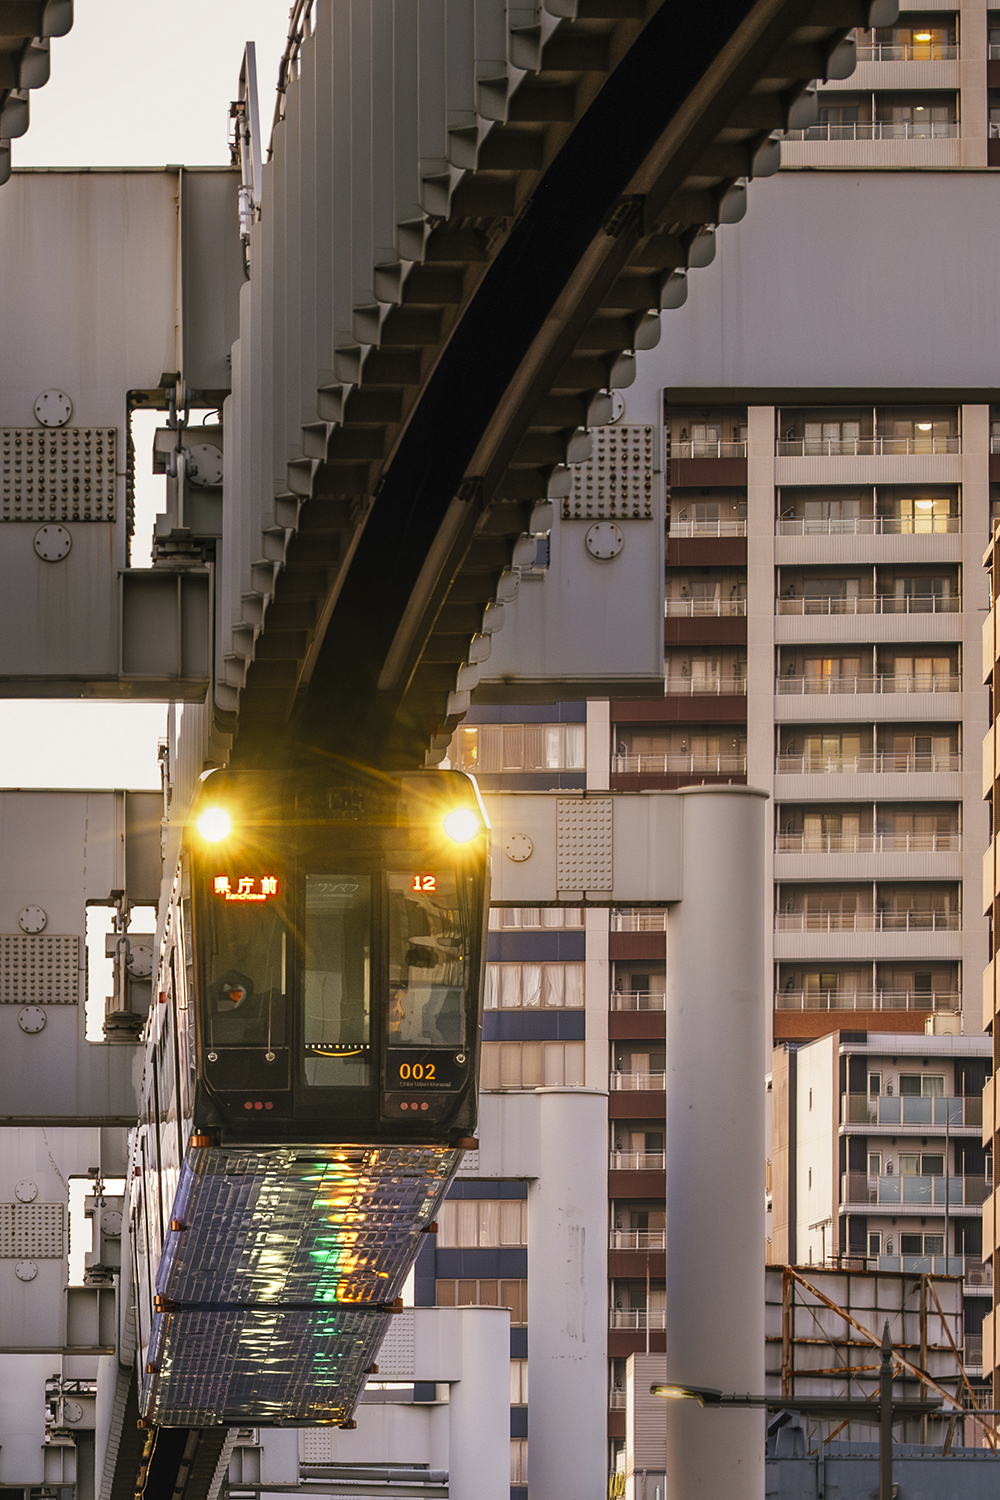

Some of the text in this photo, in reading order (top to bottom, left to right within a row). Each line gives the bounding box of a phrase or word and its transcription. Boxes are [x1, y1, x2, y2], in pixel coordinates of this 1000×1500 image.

[213, 875, 278, 894] 県庁前
[413, 875, 436, 891] 12
[400, 1063, 436, 1080] 002
